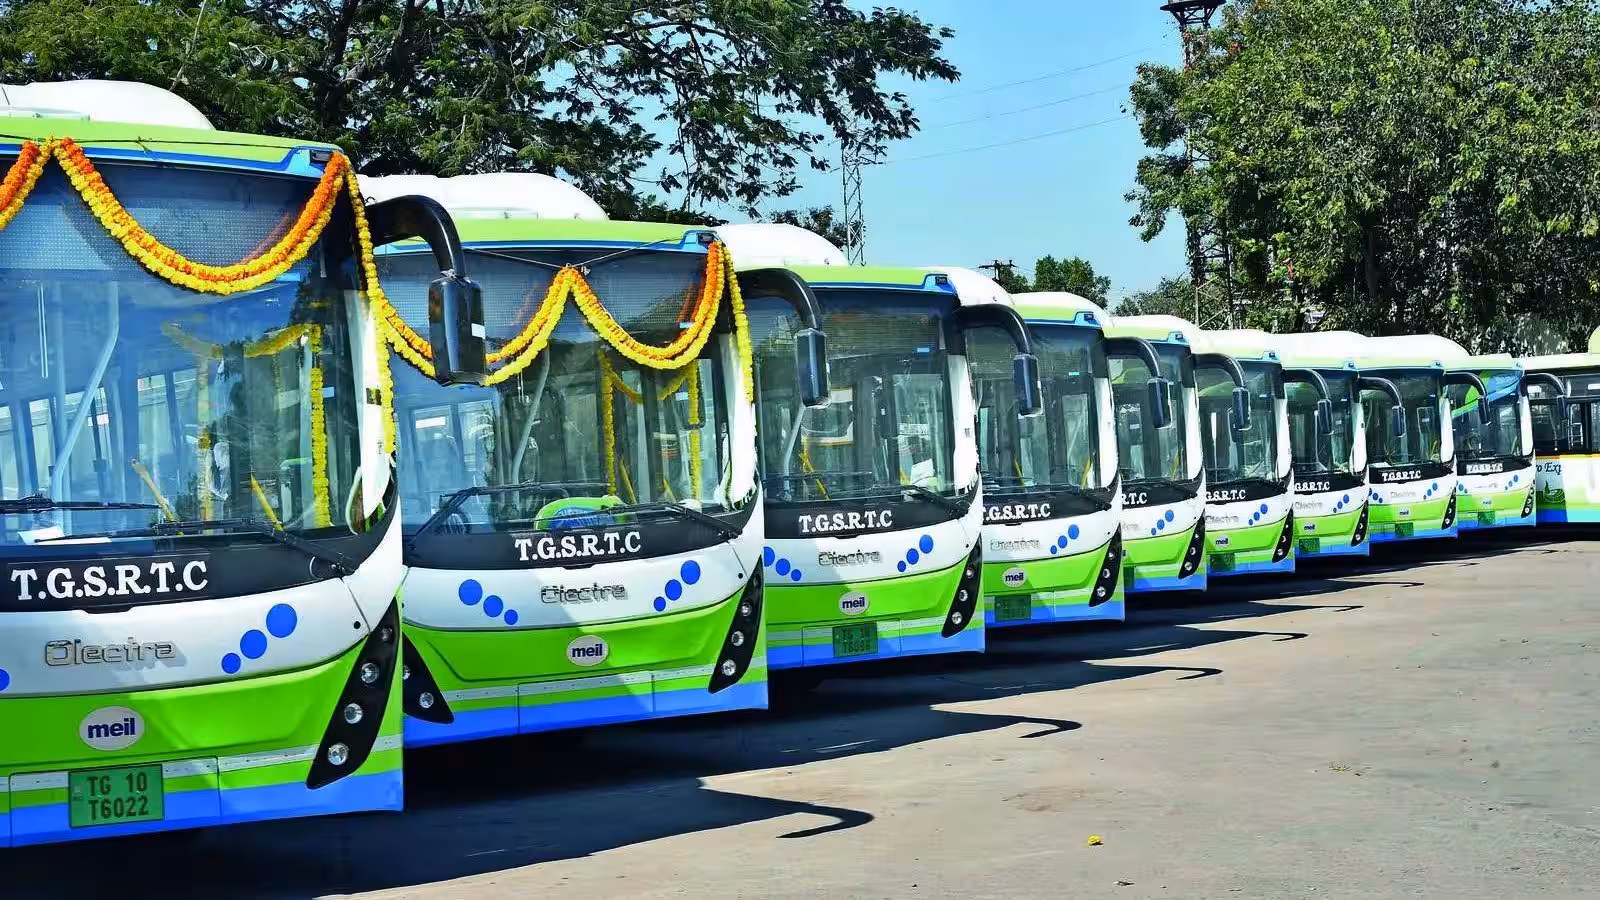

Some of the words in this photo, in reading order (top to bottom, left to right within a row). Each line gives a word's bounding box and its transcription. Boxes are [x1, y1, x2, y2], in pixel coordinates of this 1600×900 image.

[798, 510, 893, 533] T.G.S.R.T.C
[514, 531, 642, 561] T.G.S.R.T.C
[10, 560, 208, 600] T.G.S.R.T.C
[1005, 572, 1024, 582] meil
[842, 597, 865, 609] meil
[45, 637, 176, 666] Olectra
[571, 643, 603, 658] meil
[87, 718, 136, 739] meil
[87, 776, 112, 797] TG
[126, 772, 147, 793] 10
[88, 795, 149, 820] T6022
